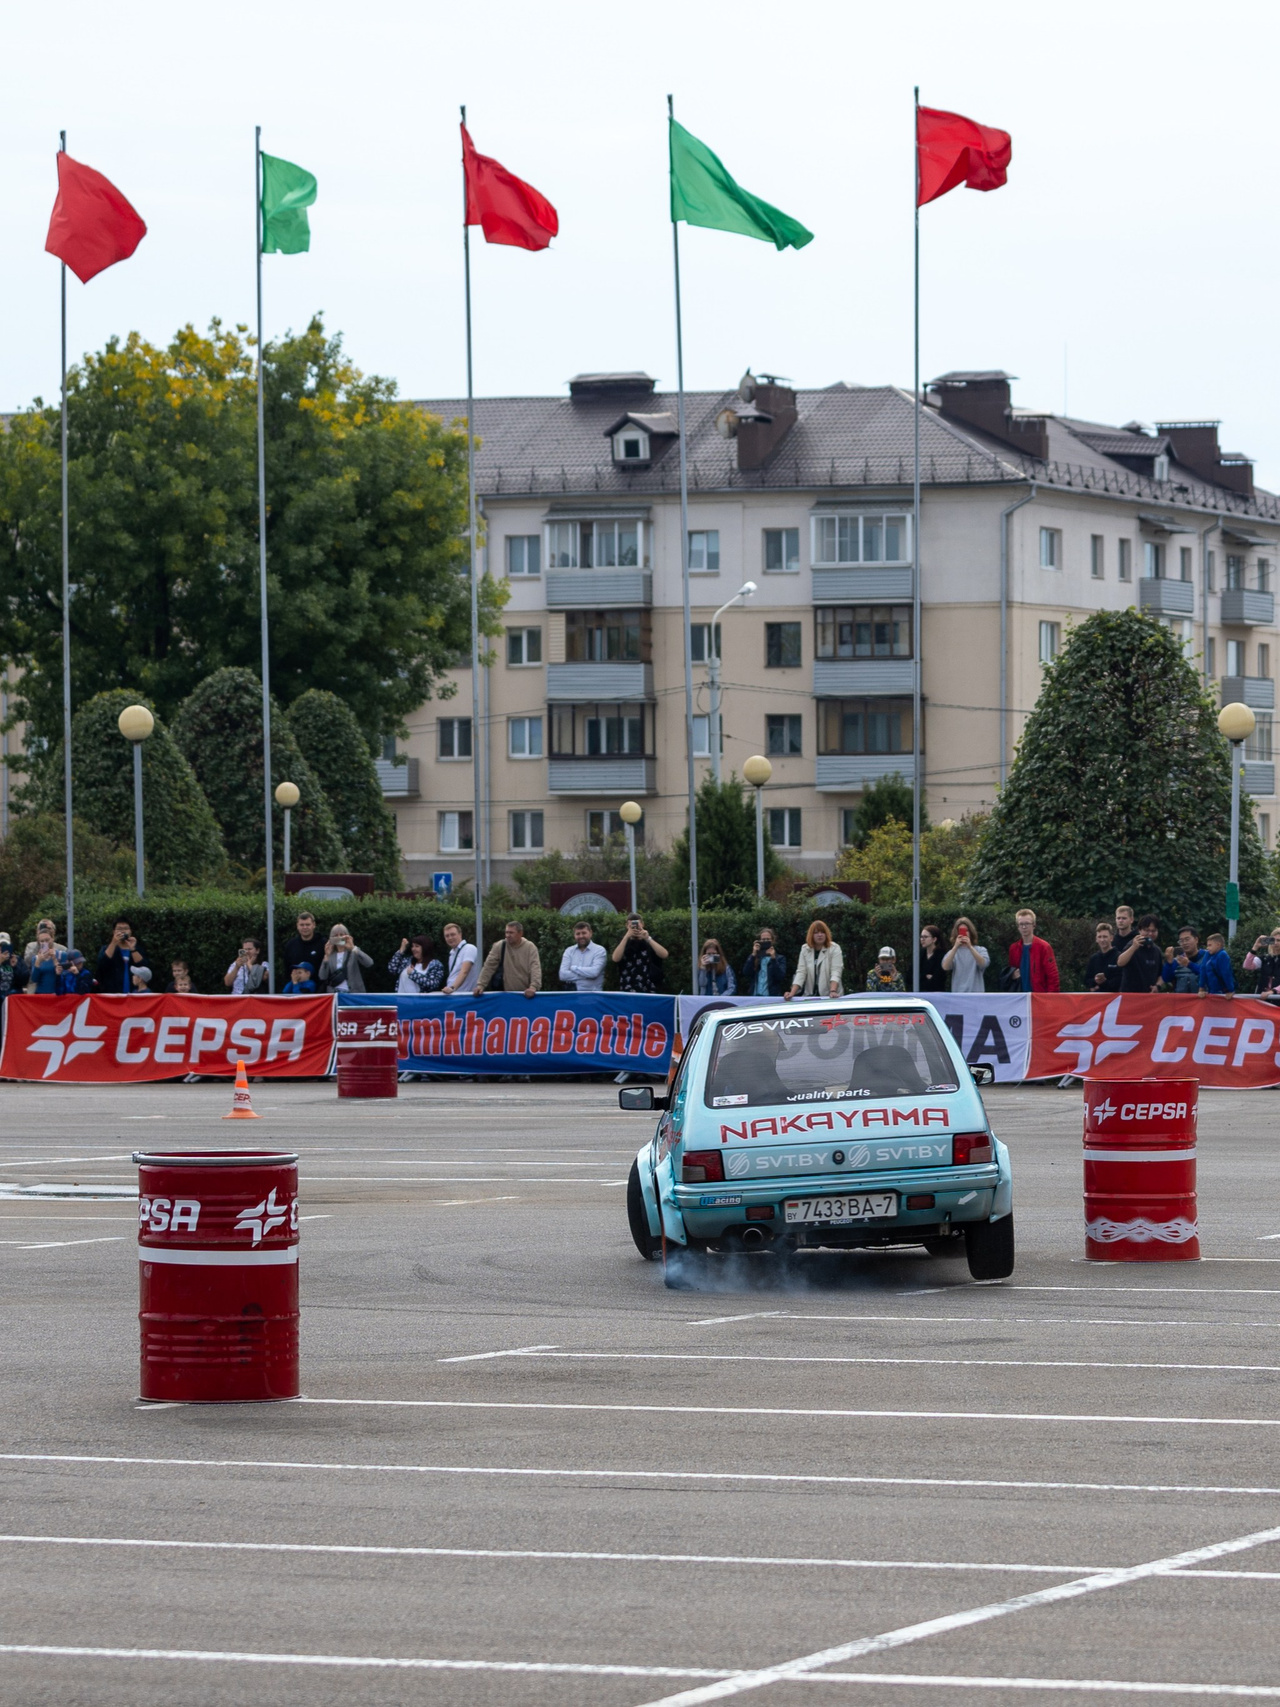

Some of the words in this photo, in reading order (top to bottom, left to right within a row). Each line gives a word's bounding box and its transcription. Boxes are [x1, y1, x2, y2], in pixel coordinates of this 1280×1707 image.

[853, 1014, 926, 1027] CEPSA
[115, 1016, 306, 1064] CEPSA
[836, 1088, 871, 1099] parts
[1120, 1102, 1187, 1121] CEPSA
[720, 1107, 950, 1144] NAKAYAMA
[756, 1152, 828, 1170] SVT.BY
[876, 1144, 948, 1162] SVT.BY
[787, 1212, 797, 1221] BY
[802, 1200, 844, 1219] 7433
[848, 1196, 893, 1216] BA-7
